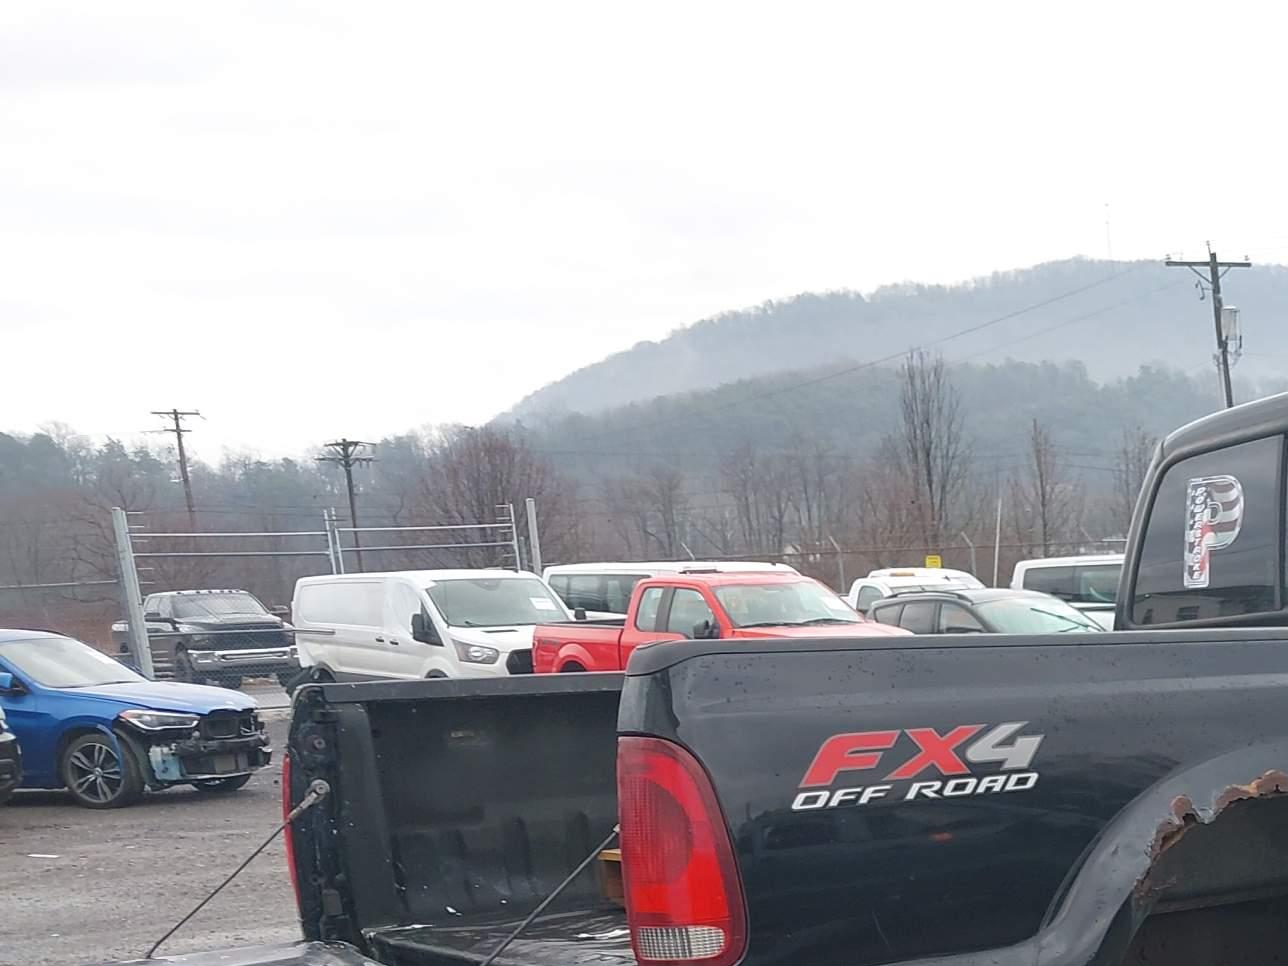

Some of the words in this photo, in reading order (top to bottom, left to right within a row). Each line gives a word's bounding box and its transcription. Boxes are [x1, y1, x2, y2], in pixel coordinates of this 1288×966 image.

[798, 720, 1044, 788] FX4
[791, 784, 893, 811] OFF
[905, 772, 1039, 801] ROAD
